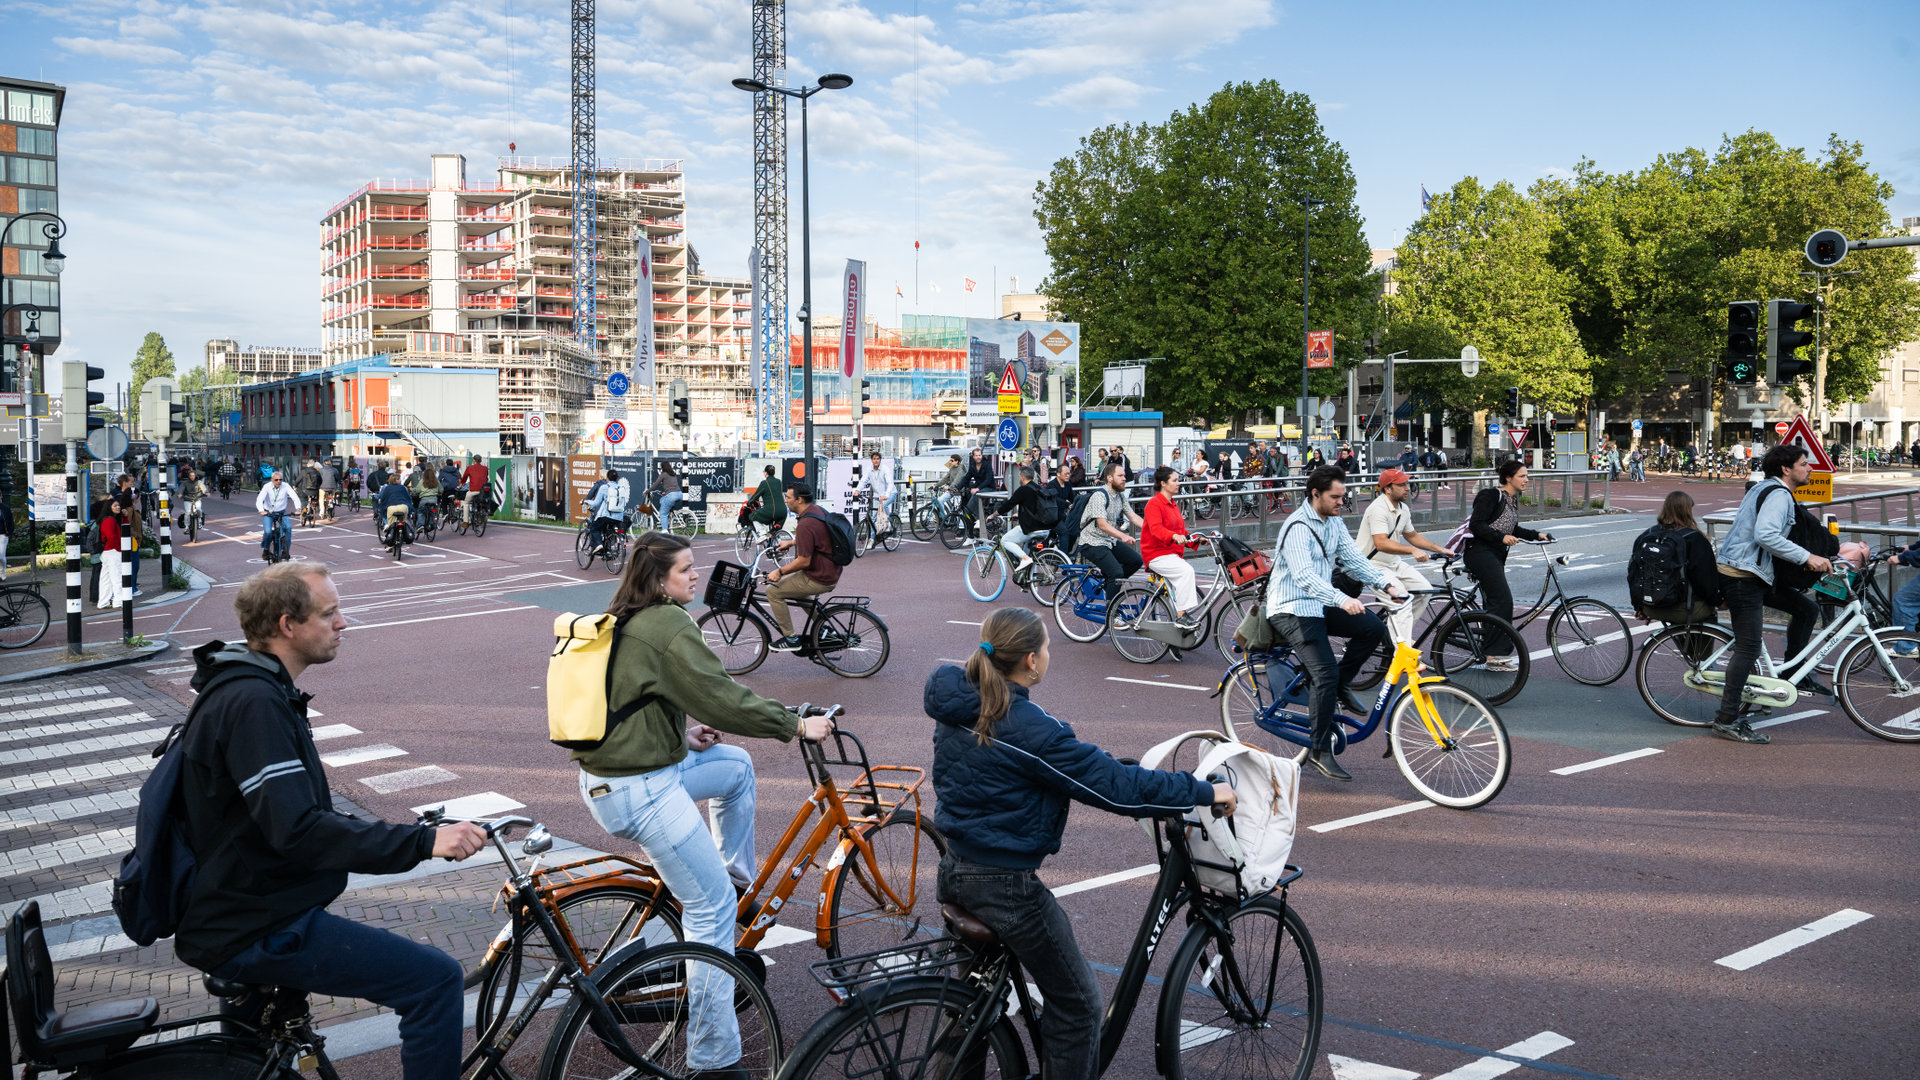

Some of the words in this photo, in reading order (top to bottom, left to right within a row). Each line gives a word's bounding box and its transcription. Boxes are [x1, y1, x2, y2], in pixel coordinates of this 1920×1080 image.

[8, 91, 56, 126] hotels.
[1816, 637, 1840, 660] Gazelle
[1375, 673, 1394, 710] OV-fiets.nl
[1147, 898, 1171, 960] ALTEC
